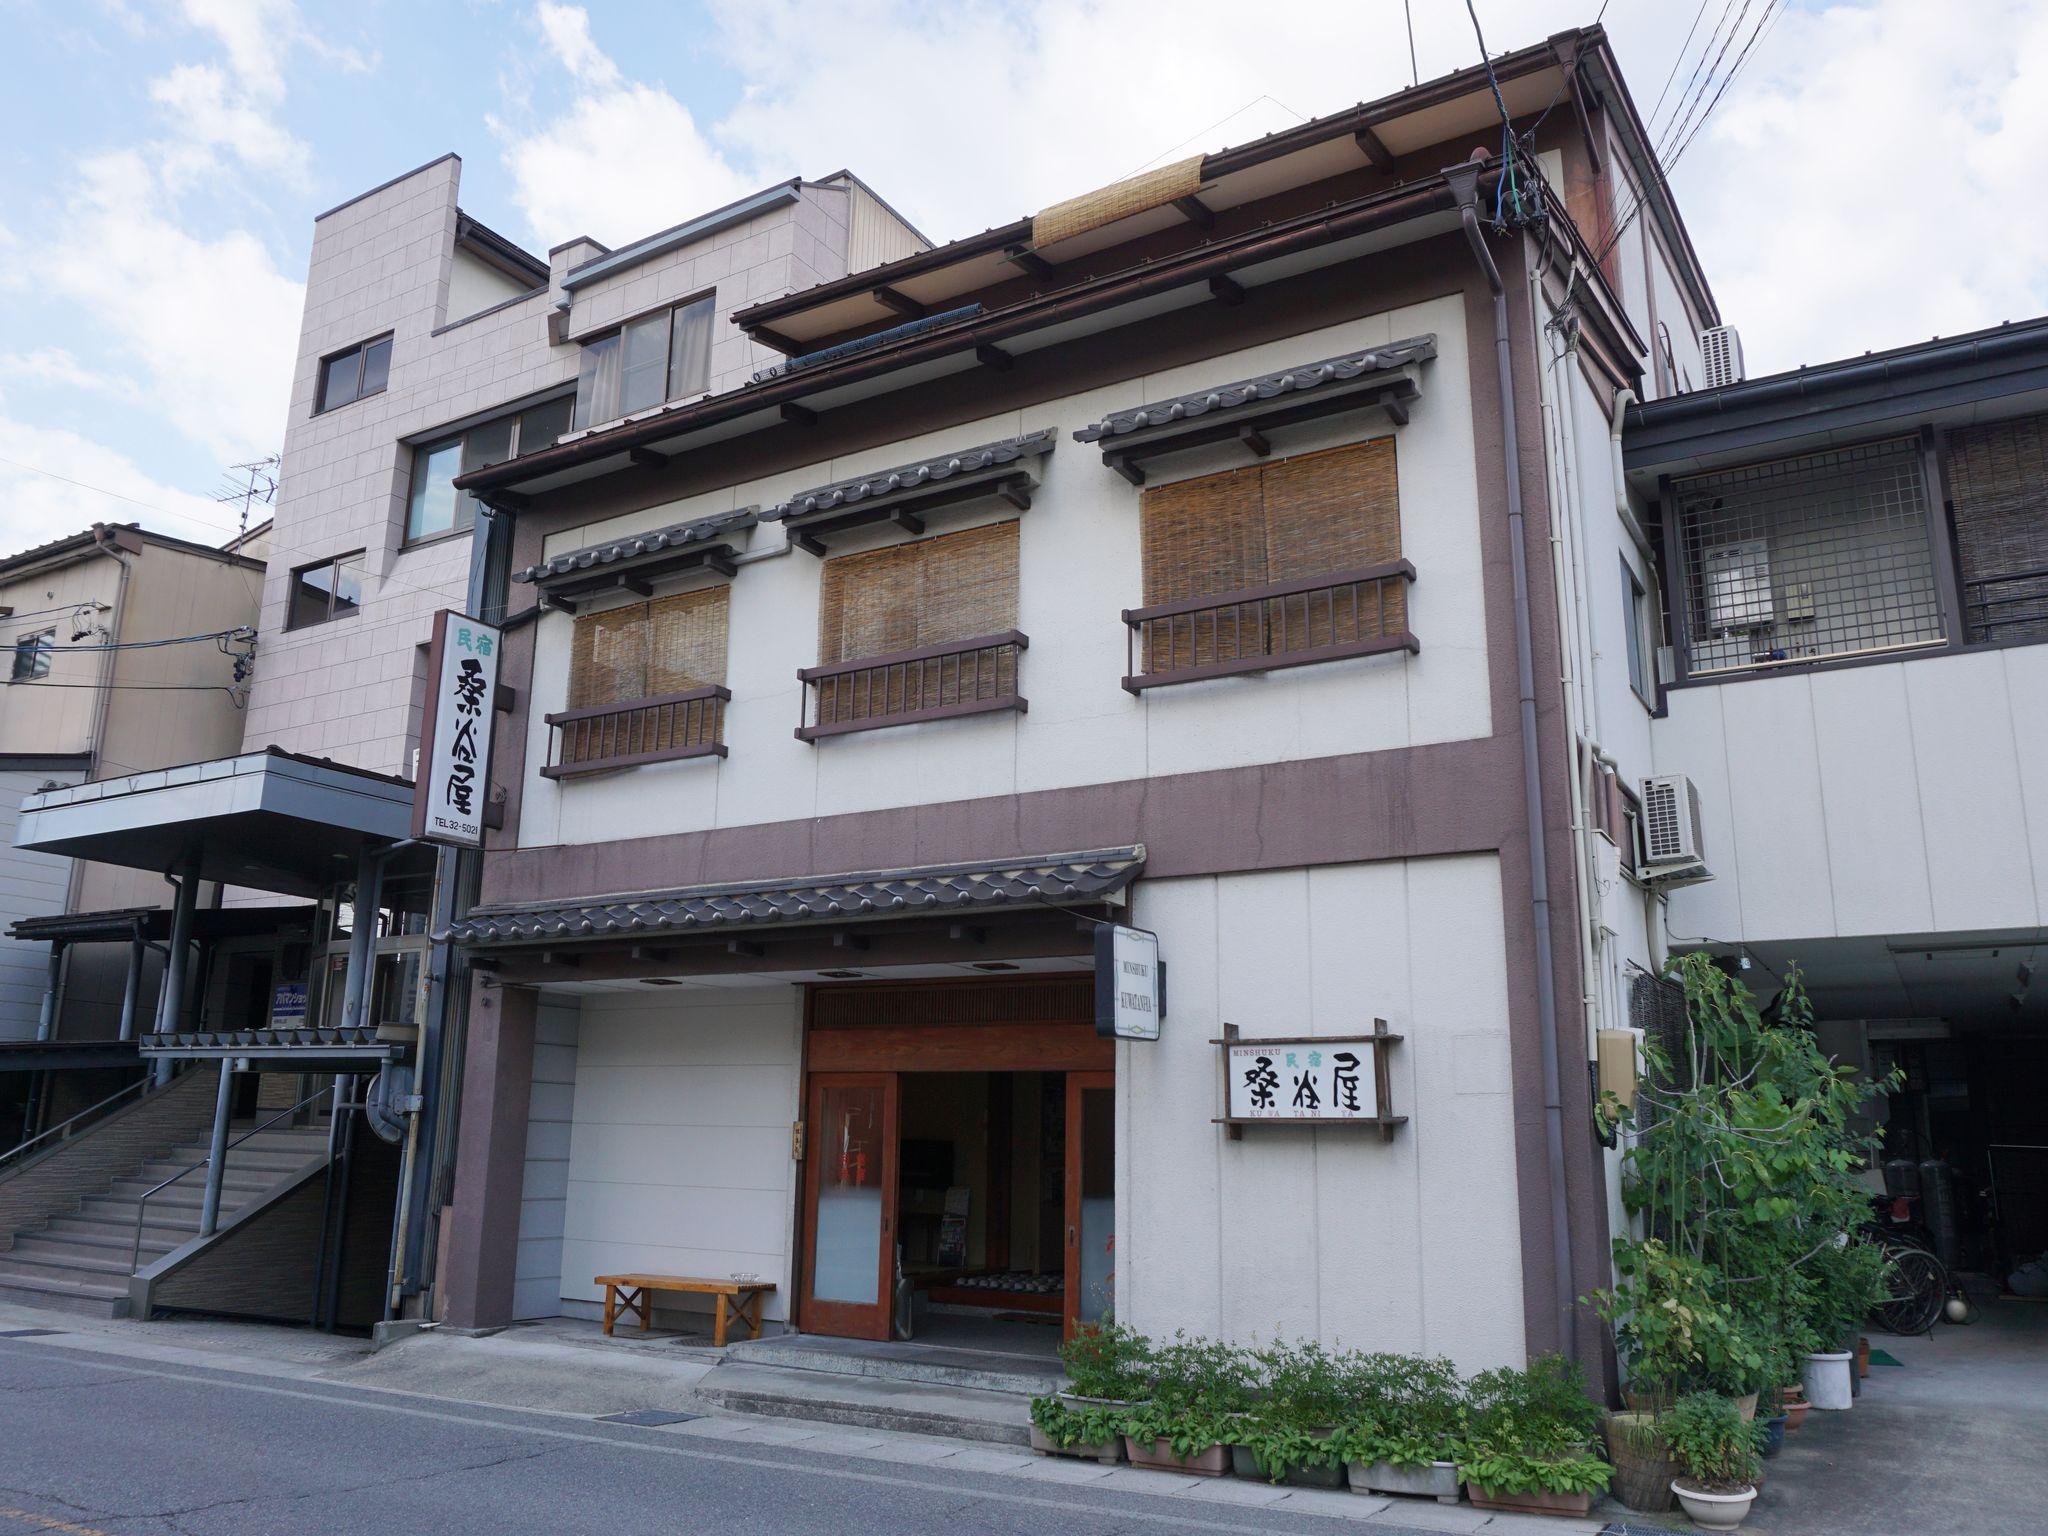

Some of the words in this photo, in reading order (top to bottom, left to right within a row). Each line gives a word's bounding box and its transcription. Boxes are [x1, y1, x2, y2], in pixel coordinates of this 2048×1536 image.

[457, 628, 493, 656] 民宿
[446, 659, 487, 815] 桑谷屋
[1123, 961, 1148, 977] MINSHUKU
[1233, 1049, 1281, 1057] MINSHUKU
[1286, 1051, 1322, 1069] 民宿
[1243, 1052, 1361, 1112] 桑谷屋
